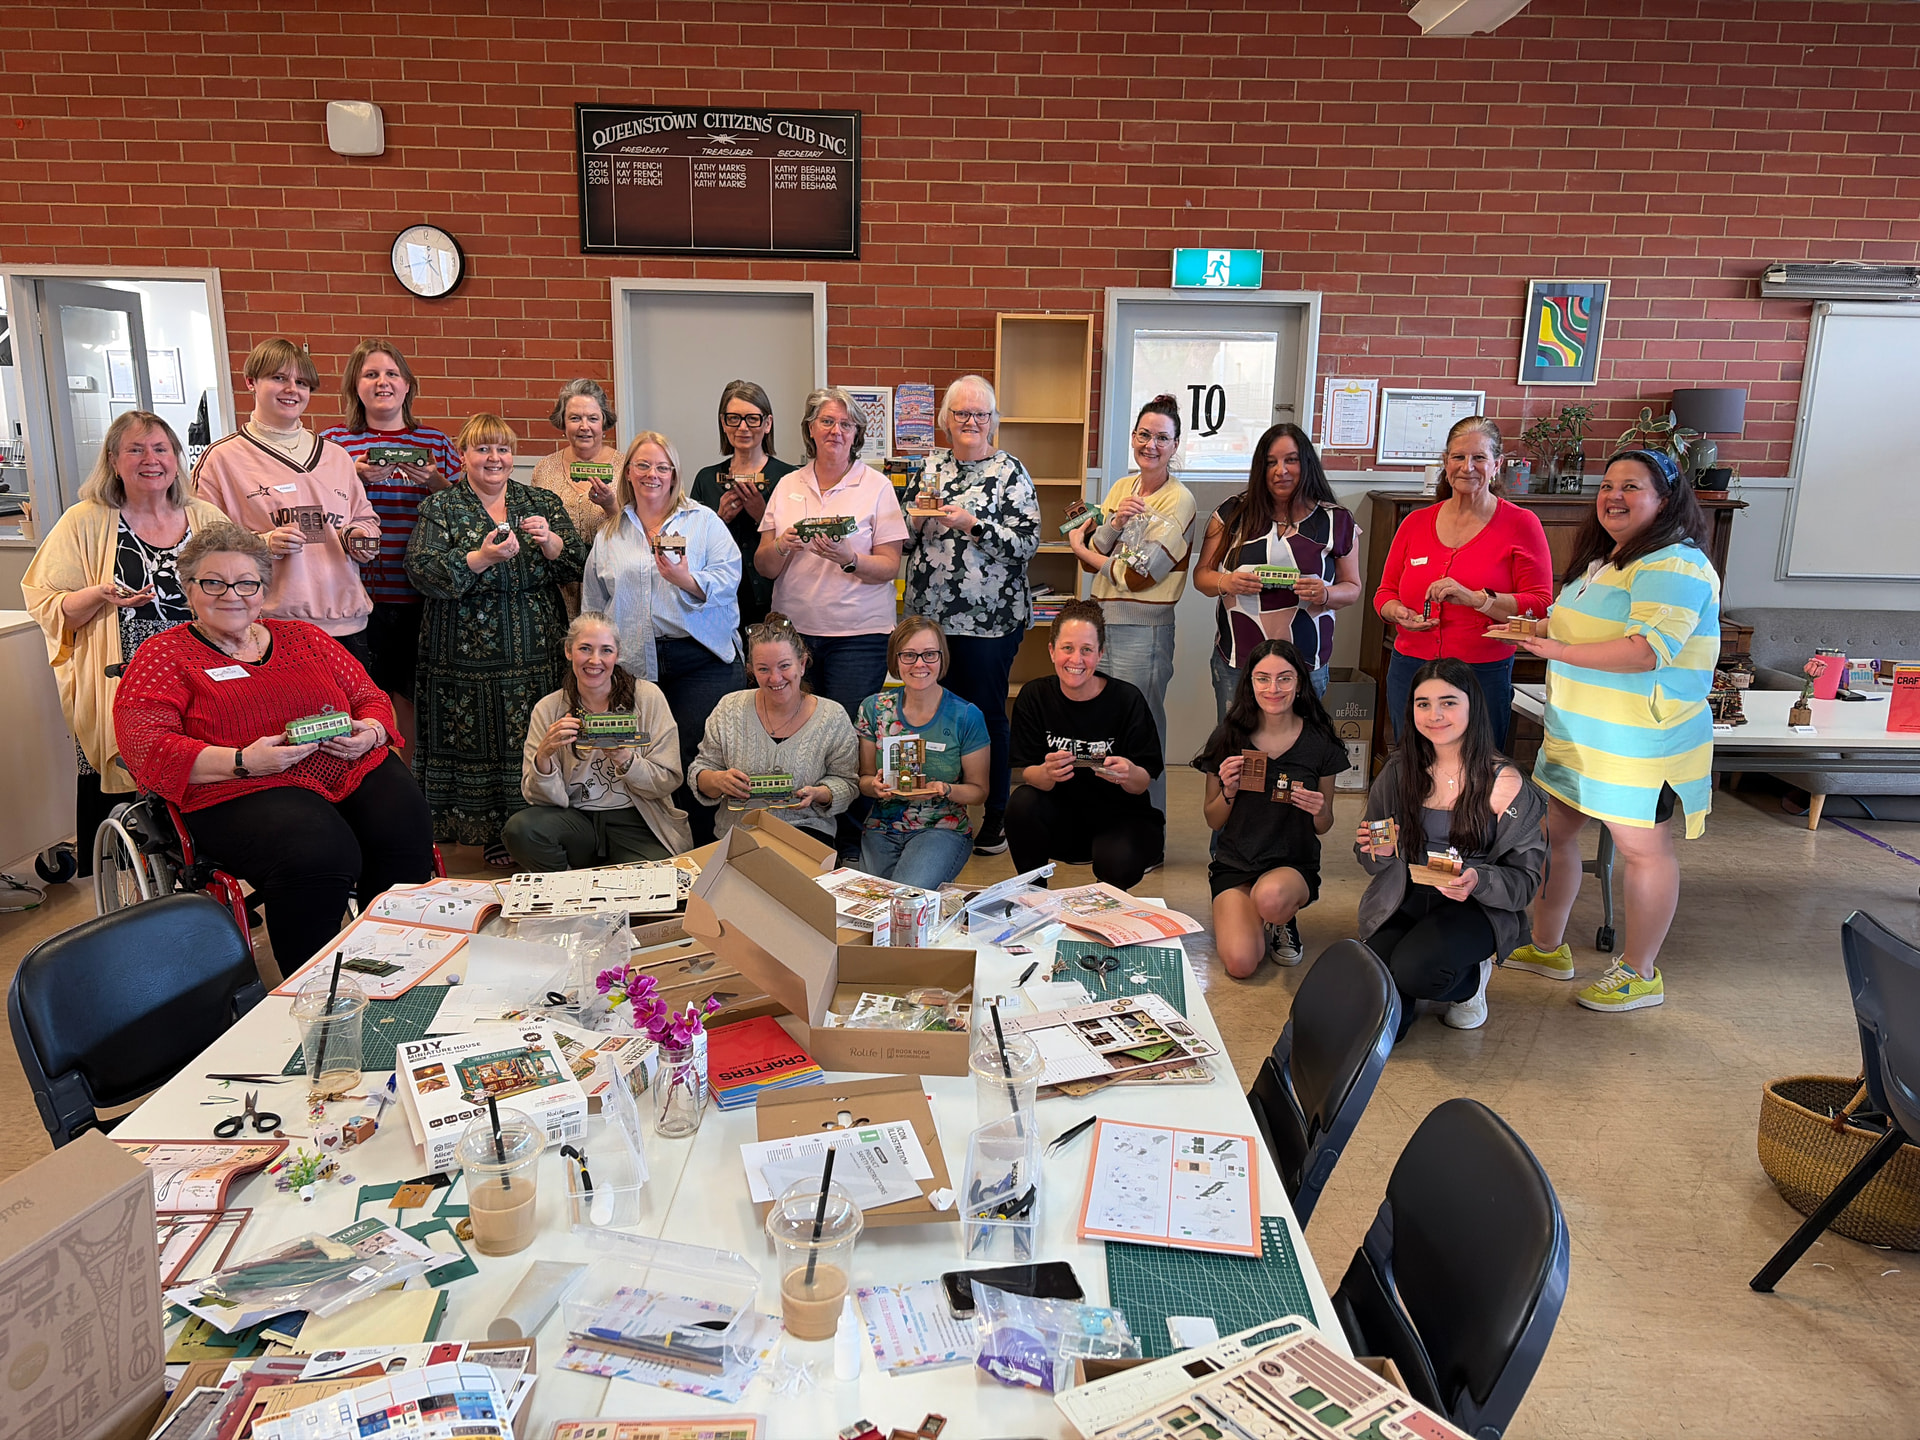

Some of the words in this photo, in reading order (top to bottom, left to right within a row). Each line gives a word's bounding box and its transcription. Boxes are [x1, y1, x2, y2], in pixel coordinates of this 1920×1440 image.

[592, 113, 698, 150] QUEENSTOWN
[703, 112, 772, 133] CITIZENS
[777, 121, 815, 144] CLUB
[818, 132, 847, 156] INC.
[620, 146, 670, 155] PRESIDENT
[701, 147, 754, 157] TREASURER
[777, 149, 823, 158] SECRETARY
[588, 160, 609, 169] 2014
[616, 161, 631, 169] KAY
[633, 161, 662, 170] FRENCH
[693, 163, 717, 172] KATHY
[718, 163, 746, 172] MARKS
[588, 168, 609, 177] 2015
[616, 169, 631, 178] KAY
[633, 170, 663, 179] FRENCH
[774, 165, 798, 174] KATHY
[800, 165, 836, 174] BESHARA
[694, 171, 717, 180] KATHY
[718, 172, 747, 181] MARKS
[775, 173, 798, 182] KATHY
[800, 174, 837, 183] BESHARA
[588, 177, 610, 186] 2016
[616, 178, 631, 186] KAY
[633, 178, 663, 187] FRENCH
[694, 179, 717, 188] KATHY
[718, 180, 746, 189] MARKS
[775, 181, 798, 190] KATHY
[801, 181, 838, 190] BESHARA
[1187, 384, 1226, 437] TQ
[1345, 702, 1359, 710] 10c
[1336, 709, 1368, 717] DEPOSIT
[405, 1040, 442, 1056] DIY
[407, 1046, 453, 1060] MINIATURE
[453, 1041, 482, 1051] HOUSE
[718, 1054, 807, 1081] CRAFTERS
[896, 1127, 908, 1140] ICON
[887, 1128, 908, 1165] ILLUSTRATION
[434, 1150, 454, 1159] Alice'
[864, 1149, 880, 1168] PRODUCT
[434, 1157, 454, 1165] Store
[867, 1164, 888, 1195] INSTRUCTIONS
